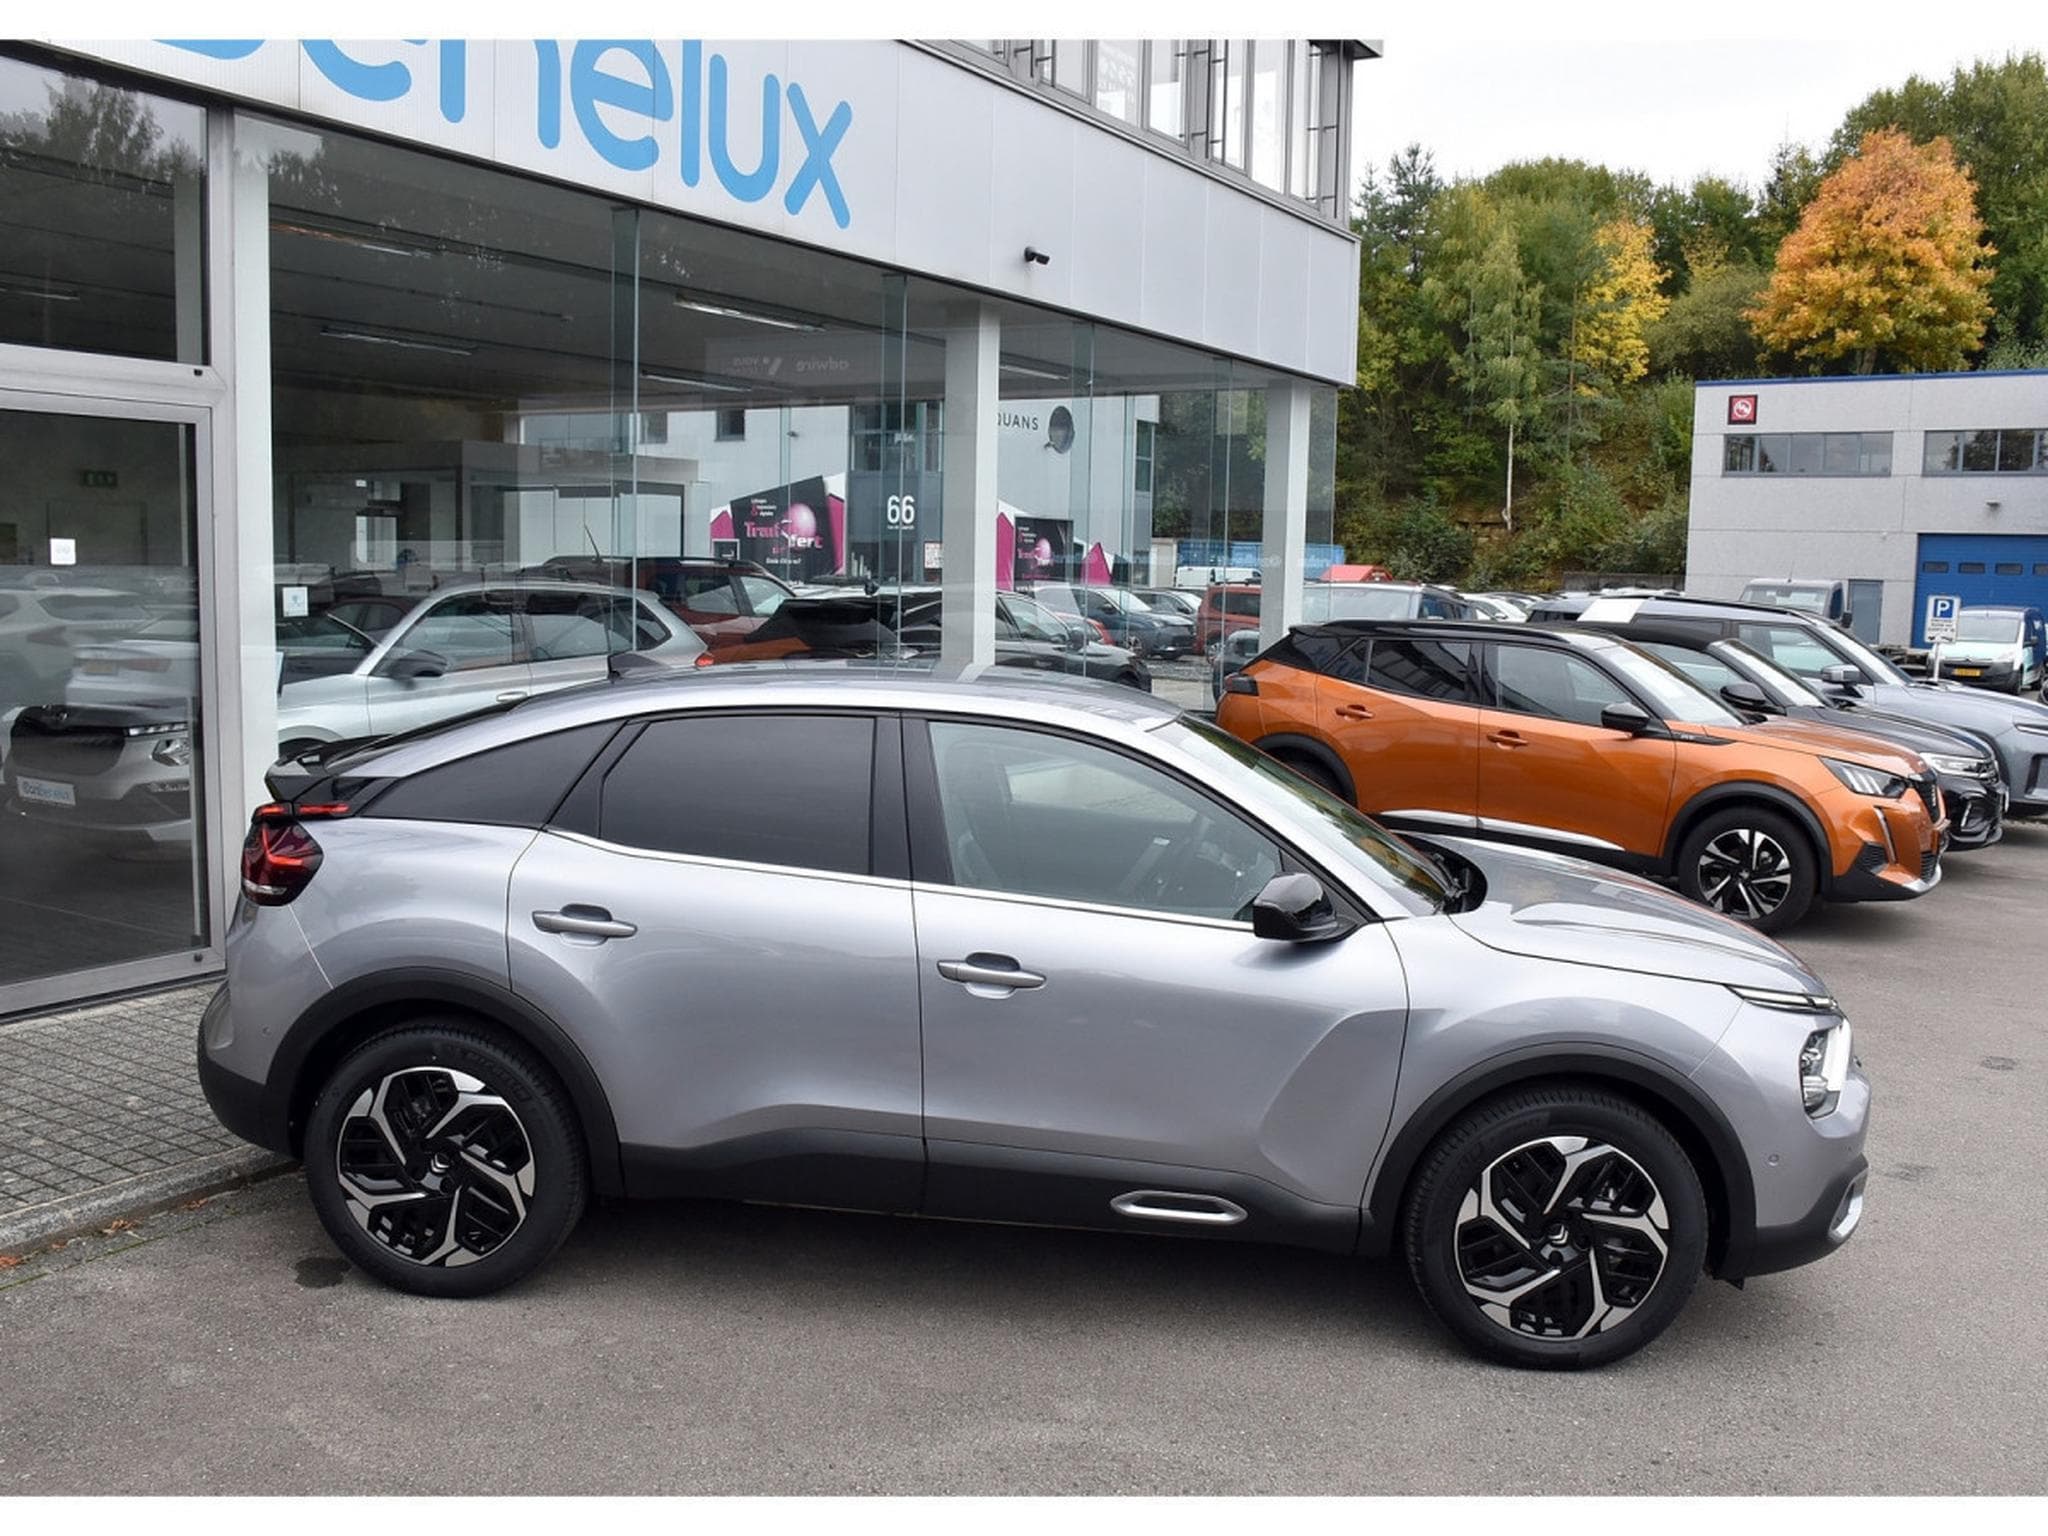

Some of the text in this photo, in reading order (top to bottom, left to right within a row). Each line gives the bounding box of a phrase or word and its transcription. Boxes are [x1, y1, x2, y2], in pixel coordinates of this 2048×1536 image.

[997, 413, 1039, 431] UANS
[887, 495, 915, 525] 66
[1936, 600, 1951, 617] P
